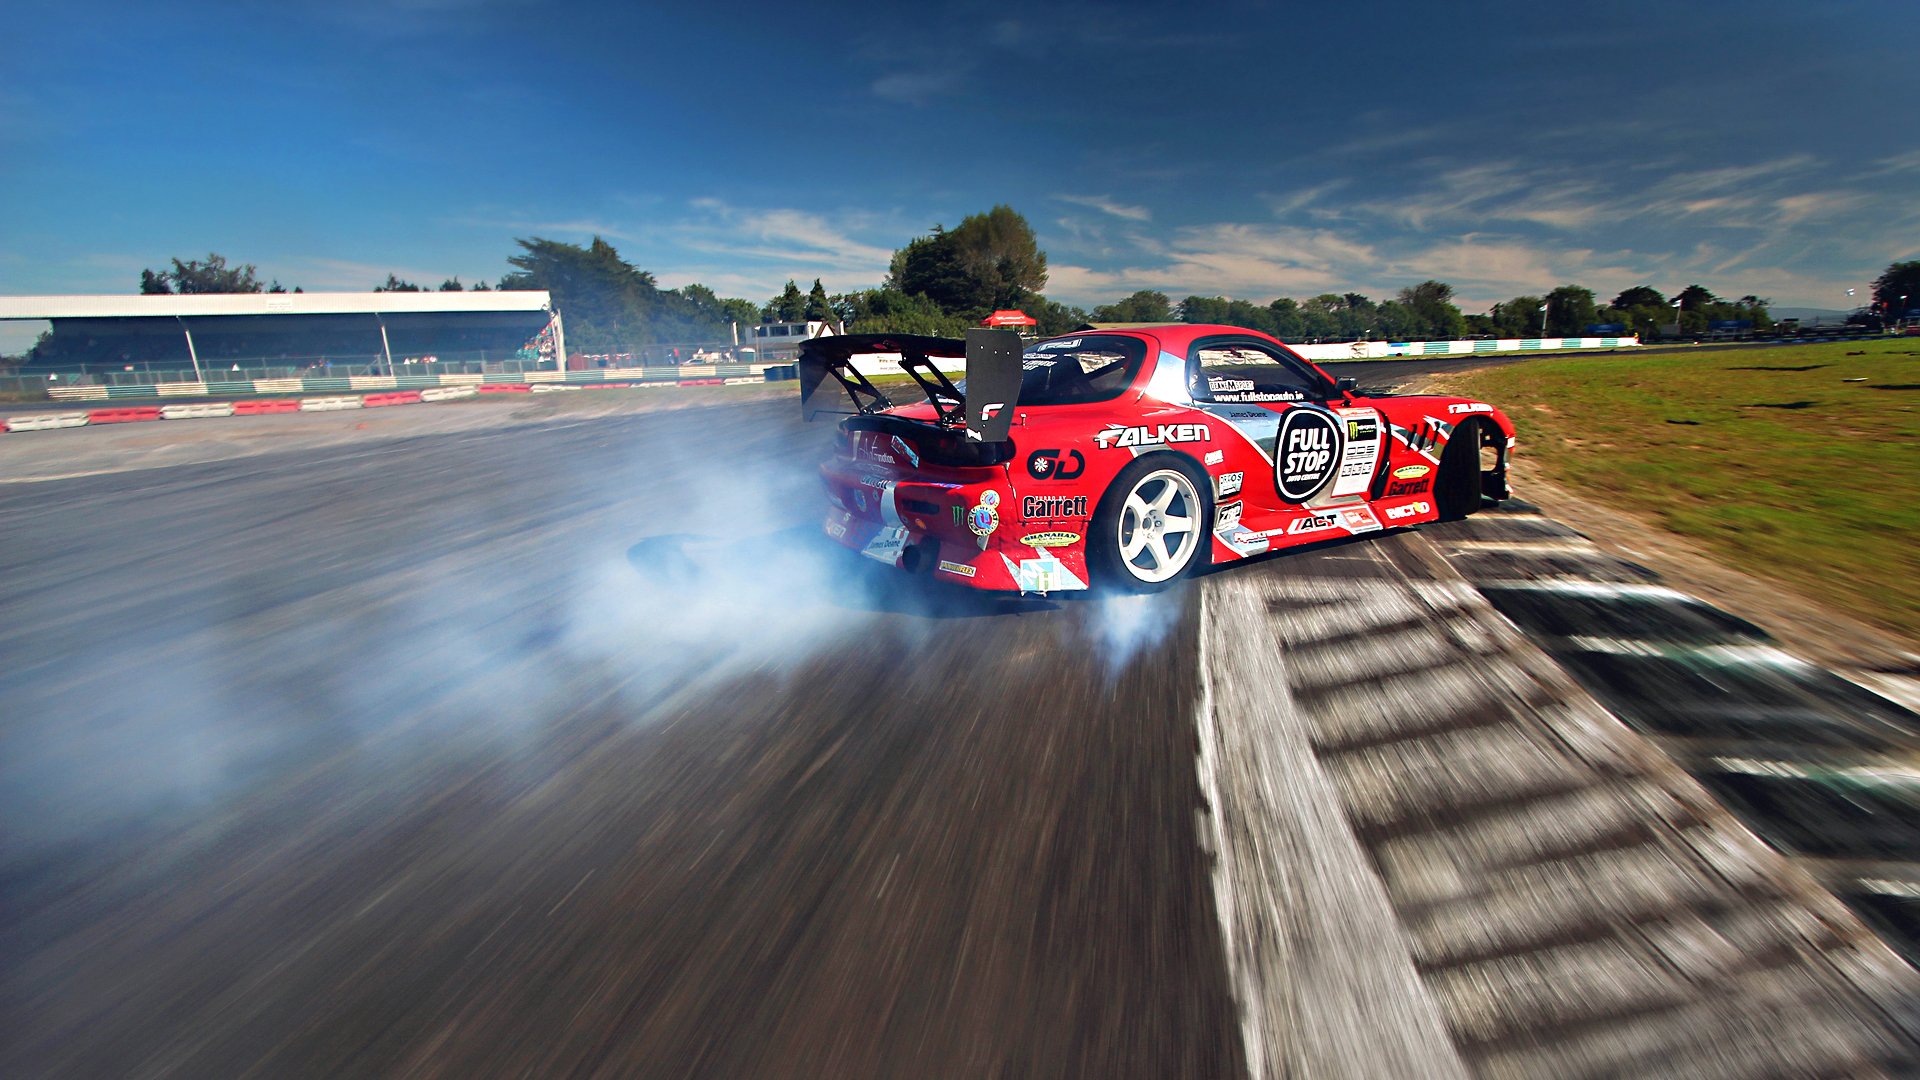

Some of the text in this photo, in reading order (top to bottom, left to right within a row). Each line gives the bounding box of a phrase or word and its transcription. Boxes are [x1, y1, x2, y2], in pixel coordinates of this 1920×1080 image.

[1094, 425, 1211, 450] FALKEN
[1288, 428, 1330, 452] FULL
[1283, 450, 1330, 474] STOP.
[1286, 474, 1302, 482] AUTO
[1390, 479, 1430, 495] Garrett
[1023, 495, 1088, 518] Garrett
[1301, 514, 1337, 529] ACT
[884, 540, 901, 548] Deane
[1024, 532, 1078, 541] SHANAHAN
